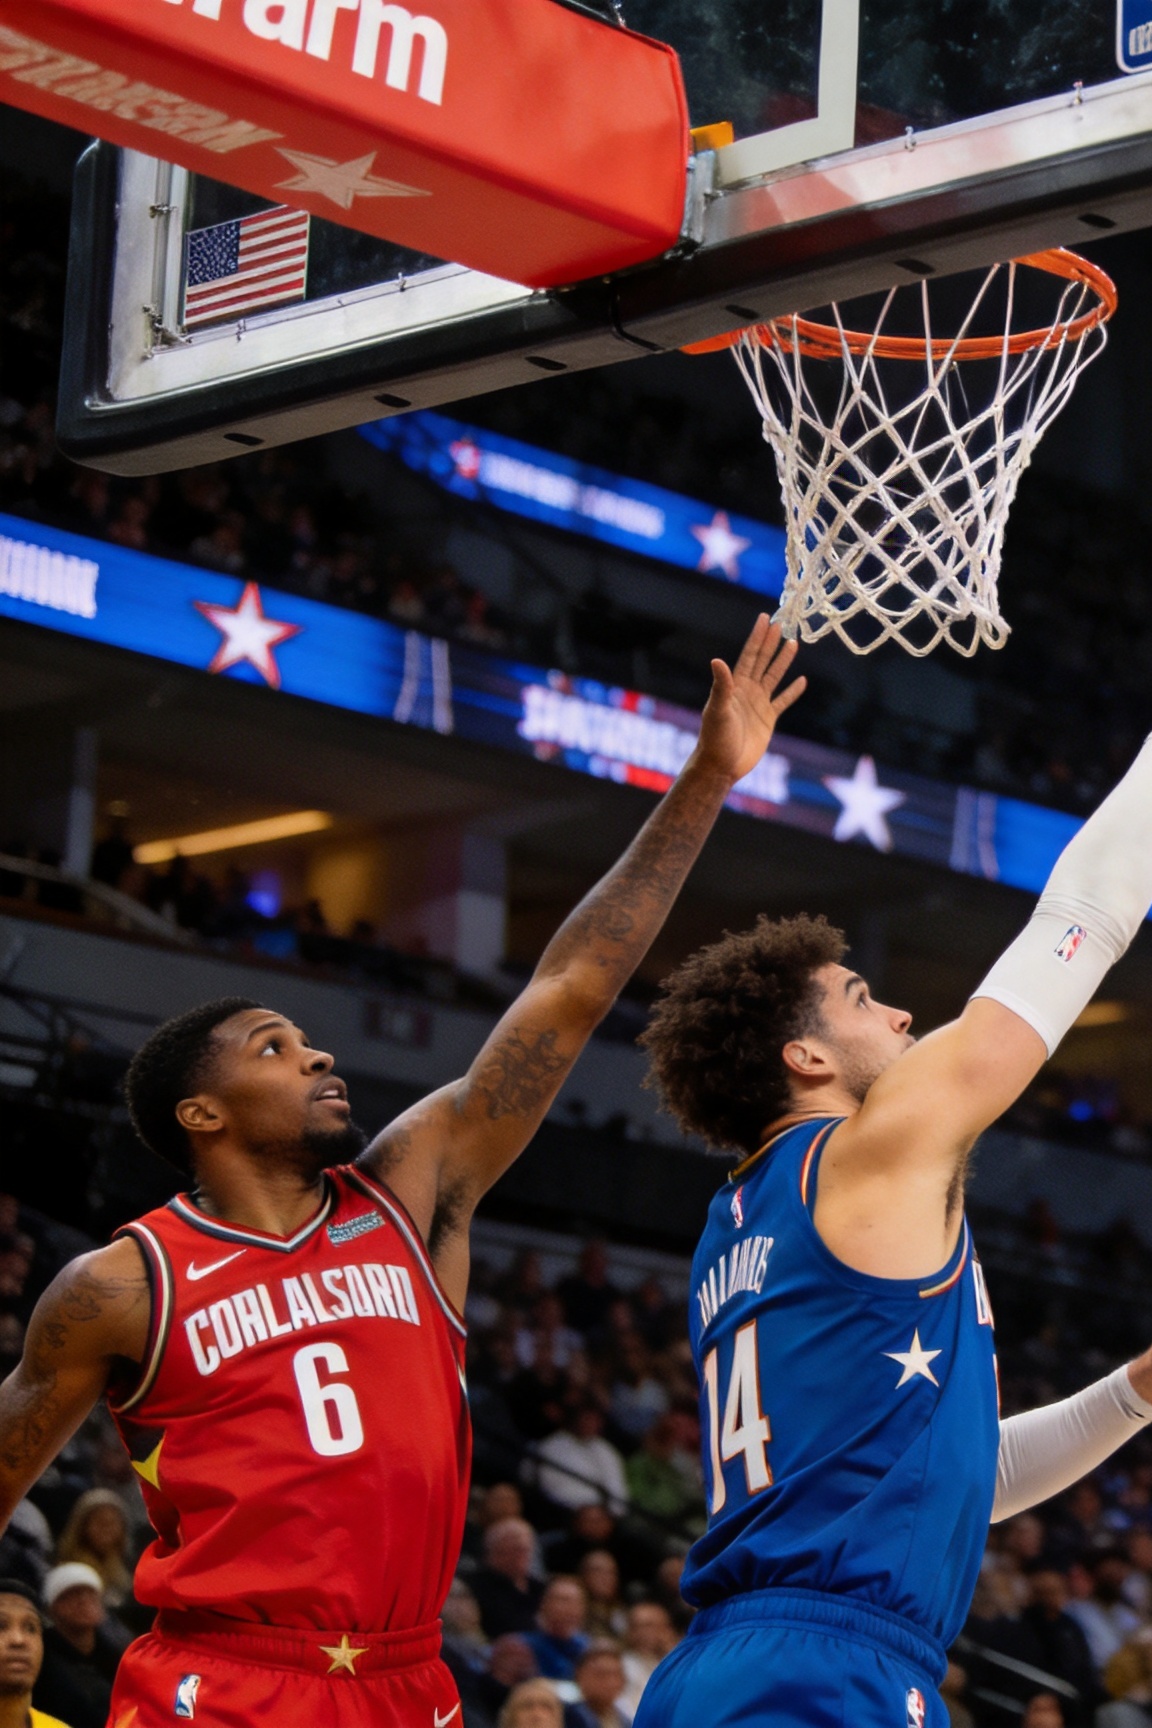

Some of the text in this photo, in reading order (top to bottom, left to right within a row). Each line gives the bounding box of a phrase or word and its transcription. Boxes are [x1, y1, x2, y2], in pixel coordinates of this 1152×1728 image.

[193, 0, 448, 106] arm
[293, 1342, 365, 1457] 6
[703, 1317, 773, 1516] 14
